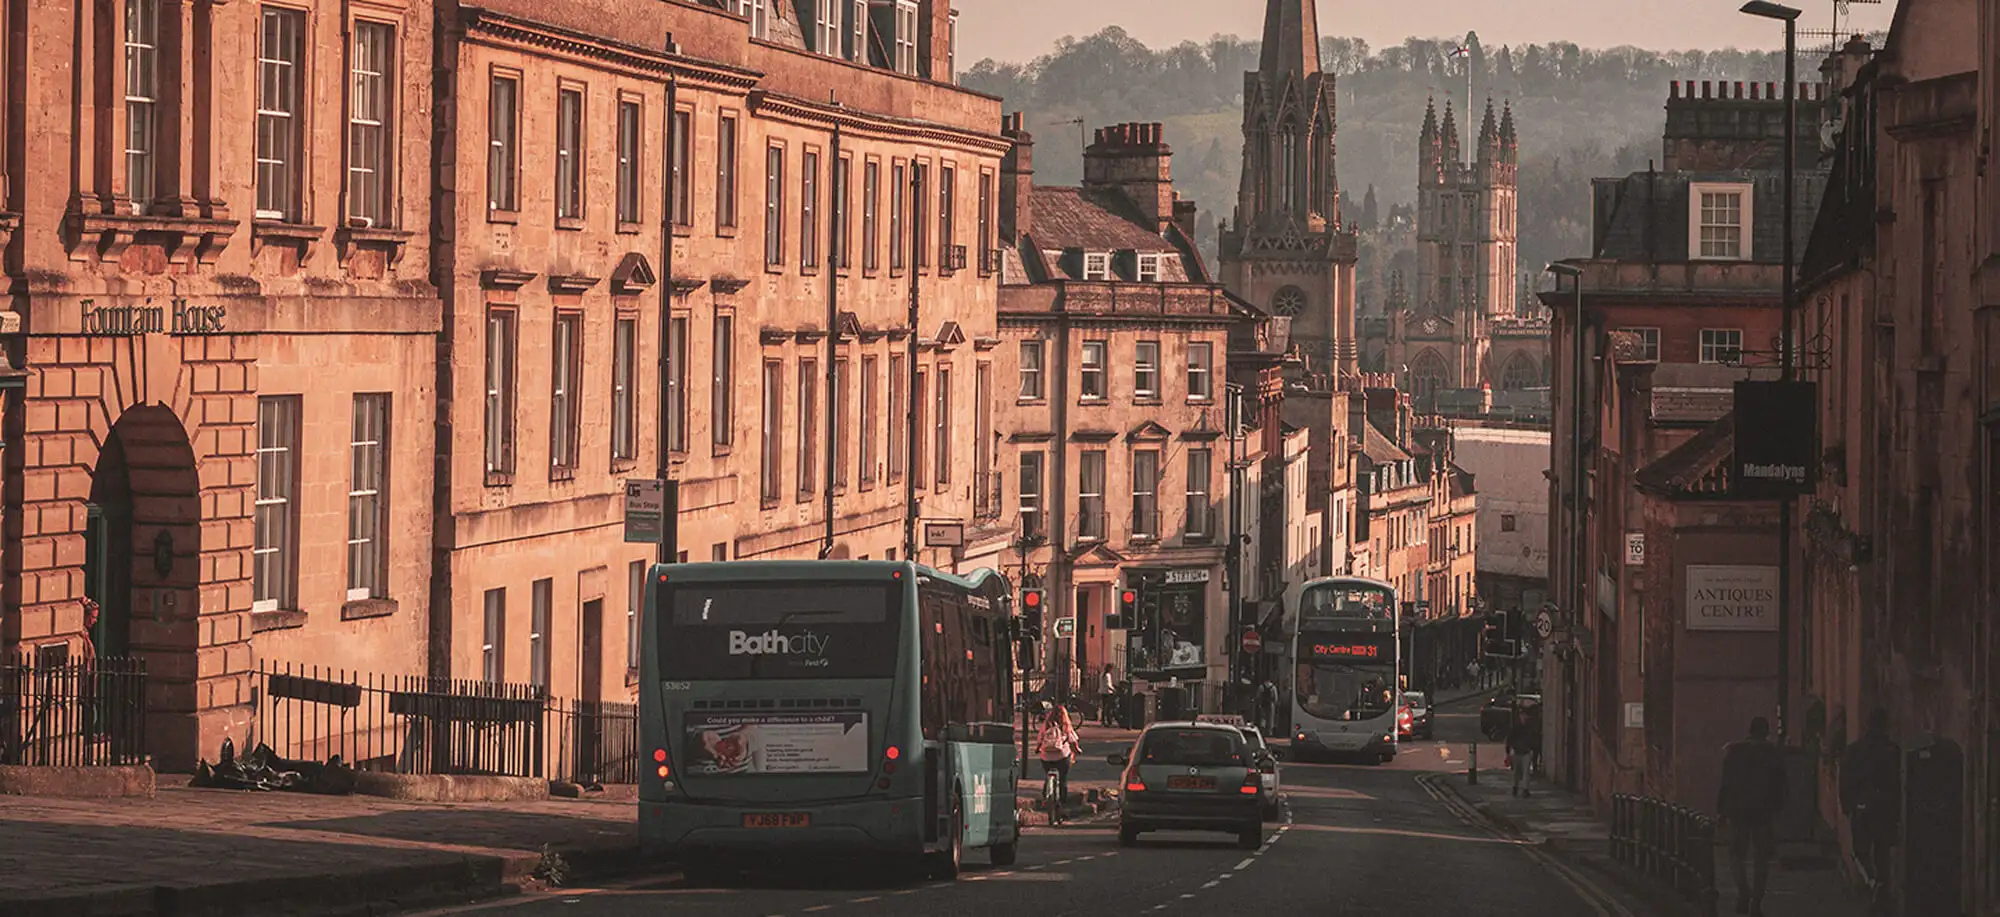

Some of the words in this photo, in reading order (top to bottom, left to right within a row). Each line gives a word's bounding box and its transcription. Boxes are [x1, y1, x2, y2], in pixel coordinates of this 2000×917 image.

[80, 297, 164, 333] Fountain
[171, 299, 226, 332] House
[1694, 588, 1774, 602] ANTIQUES
[1701, 605, 1765, 618] CENTRE
[1538, 618, 1550, 632] 20
[729, 629, 830, 656] Bathcity
[1314, 644, 1328, 655] City
[1329, 644, 1351, 654] Centre
[1367, 644, 1377, 657] 31
[707, 716, 728, 724] Could
